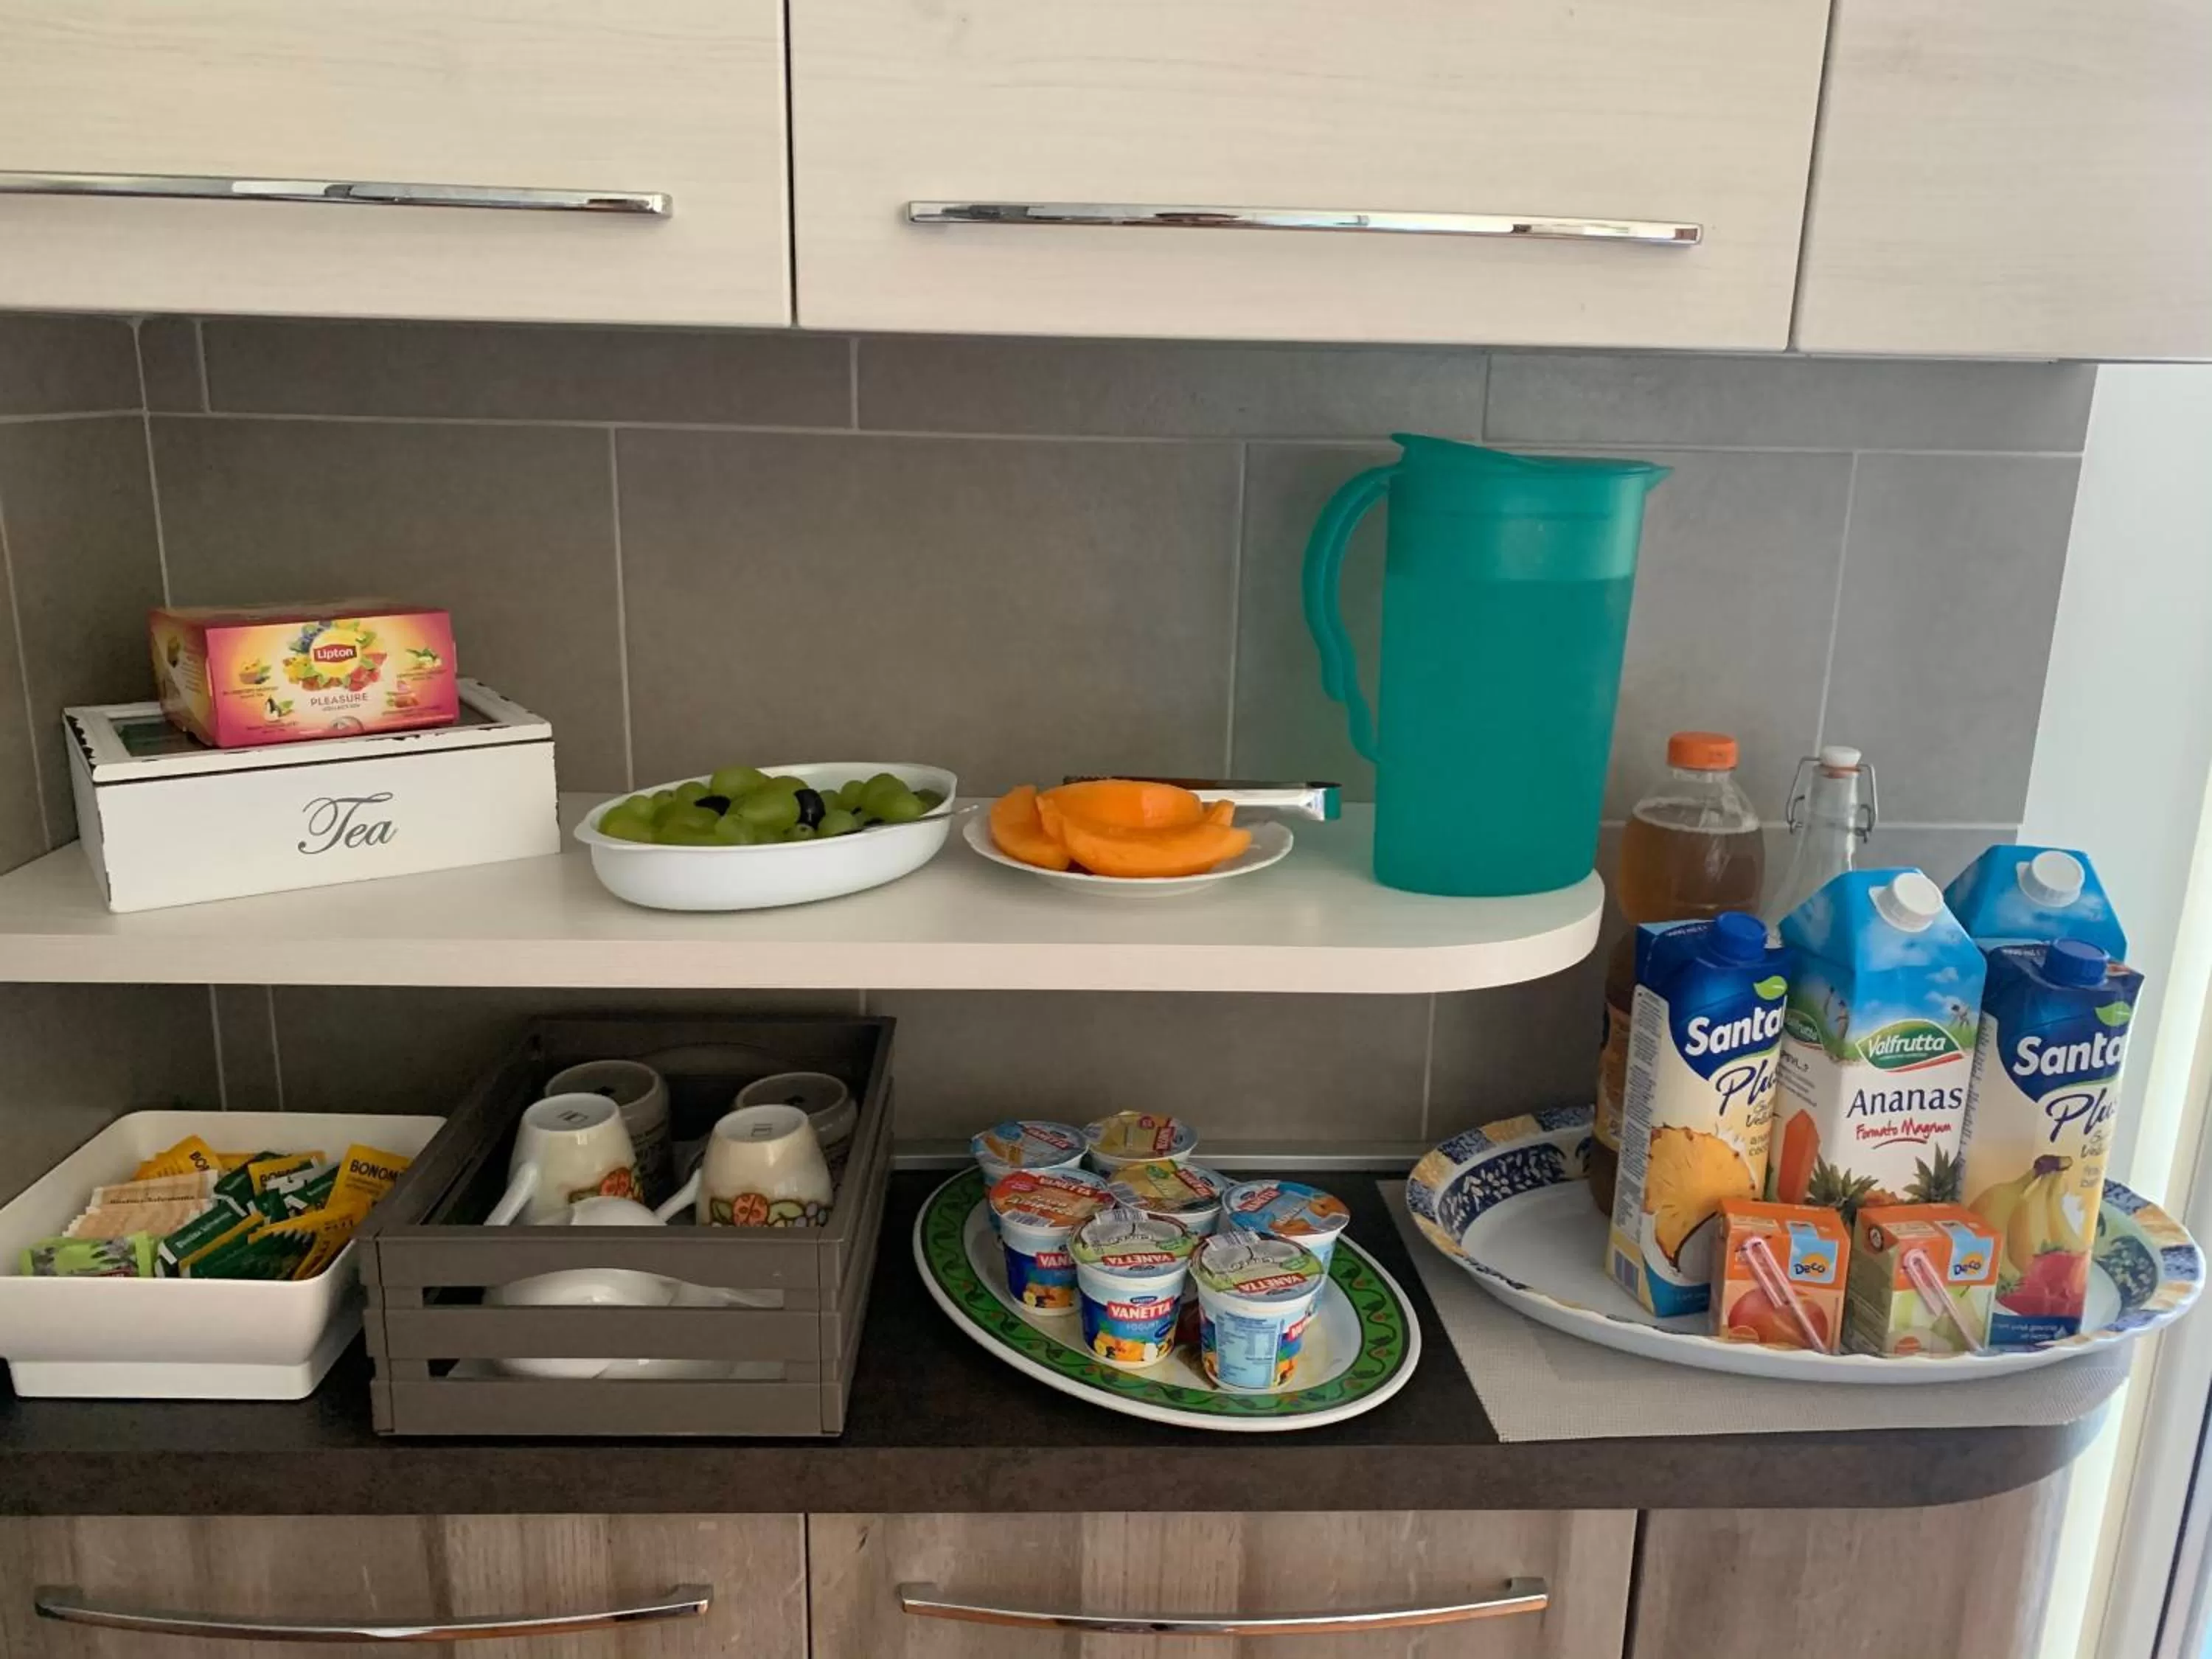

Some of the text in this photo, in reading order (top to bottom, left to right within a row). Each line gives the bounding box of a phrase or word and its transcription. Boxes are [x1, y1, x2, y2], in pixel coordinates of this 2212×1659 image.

[316, 646, 355, 661] Lipton
[310, 692, 369, 706] PLEASURE
[297, 791, 399, 855] Tea
[1868, 1034, 1946, 1058] Valfrutta
[1846, 1087, 1964, 1119] Ananas
[1856, 1117, 1952, 1141] Formato Magnum
[1039, 1177, 1092, 1196] VANETTA
[1107, 1254, 1171, 1266] VANETTA
[1794, 1262, 1825, 1275] Deco
[1238, 1273, 1304, 1291] VANETTA
[1111, 1301, 1172, 1319] VANETTA
